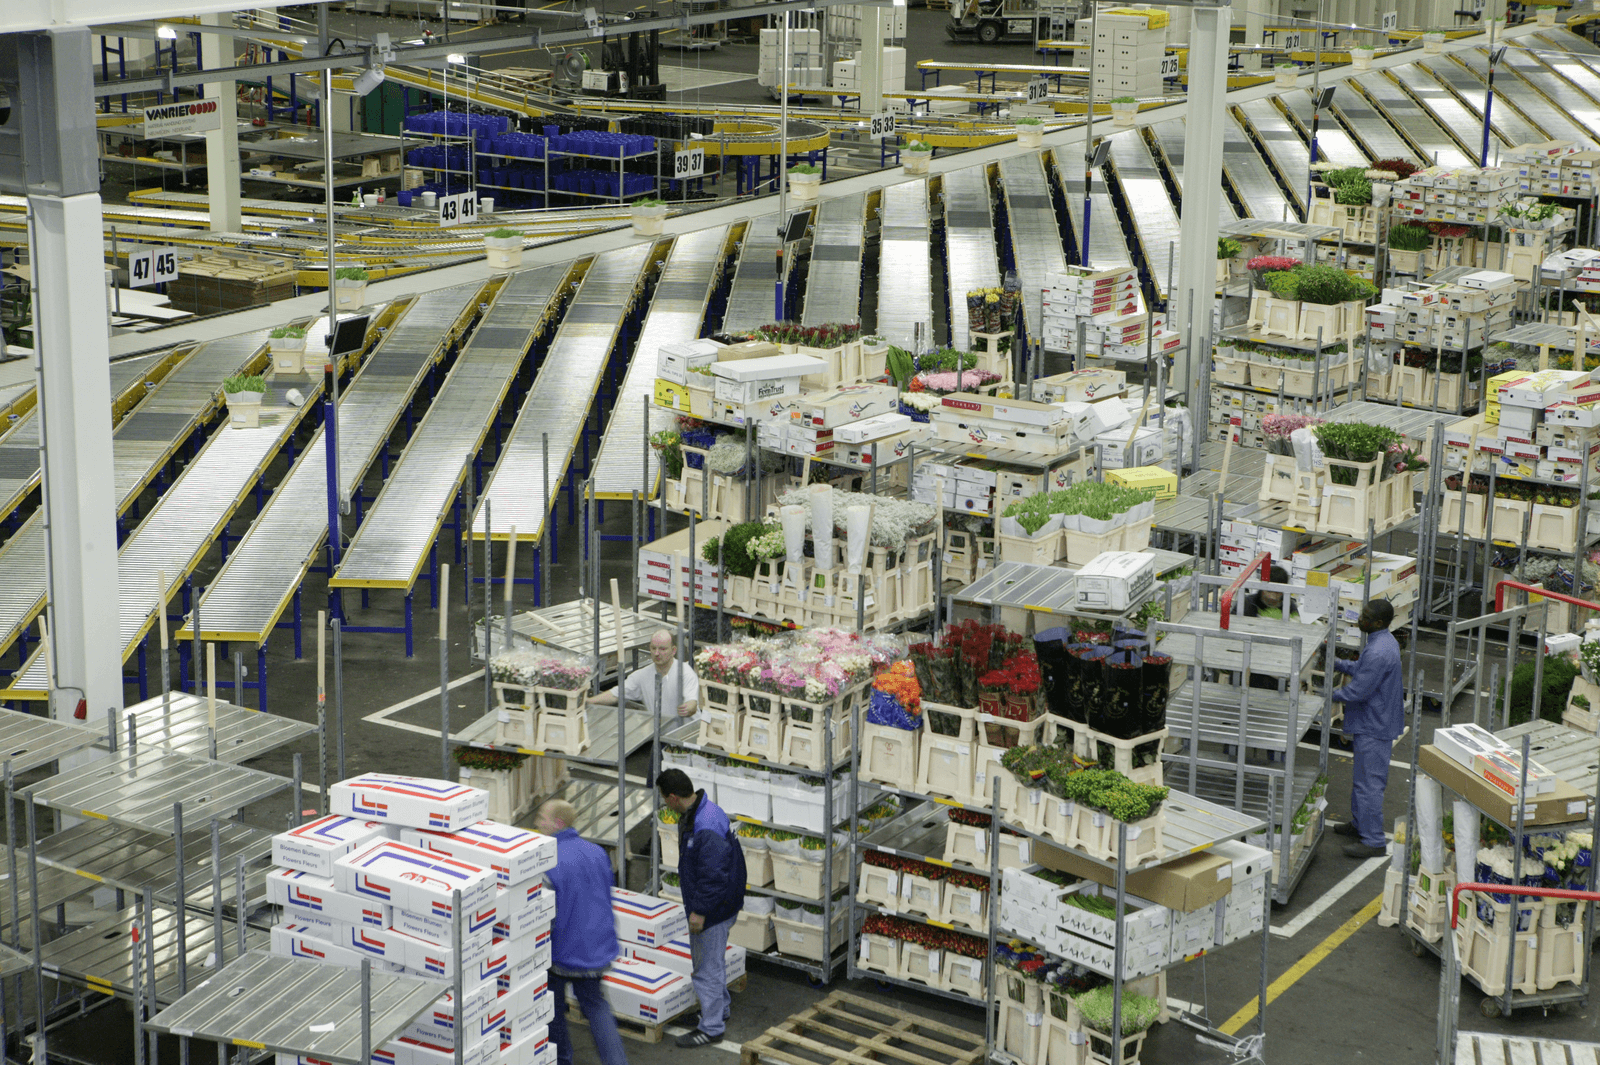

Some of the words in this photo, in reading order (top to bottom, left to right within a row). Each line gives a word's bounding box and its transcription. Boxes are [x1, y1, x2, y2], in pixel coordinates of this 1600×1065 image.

[1293, 35, 1300, 48] 21
[1161, 60, 1168, 74] 27
[1170, 59, 1178, 73] 25
[1029, 85, 1036, 99] 31
[1039, 83, 1047, 97] 29
[146, 104, 190, 121] VANRIET
[872, 119, 882, 134] 35
[884, 116, 894, 132] 33
[677, 155, 688, 173] 39
[692, 153, 702, 170] 37
[442, 201, 456, 220] 43
[462, 197, 474, 217] 41
[133, 257, 149, 280] 47
[156, 253, 175, 275] 45
[280, 844, 301, 854] Bloemen
[302, 849, 321, 858] Blumen
[283, 856, 301, 865] Flowers
[303, 860, 318, 868] Fleurs
[518, 854, 535, 866] Bloemen
[520, 865, 536, 875] Flowers
[477, 893, 489, 901] Fleurs
[294, 914, 315, 924] Flowers
[315, 919, 331, 927] Fleurs
[401, 910, 423, 922] Bloemen
[424, 917, 442, 928] Blumen
[518, 909, 534, 921] Bloemen
[404, 922, 423, 933] Flowers
[424, 928, 440, 938] Fleurs
[520, 917, 535, 930] Flowers
[416, 1028, 437, 1038] Flowers
[437, 1034, 454, 1043] Fleurs
